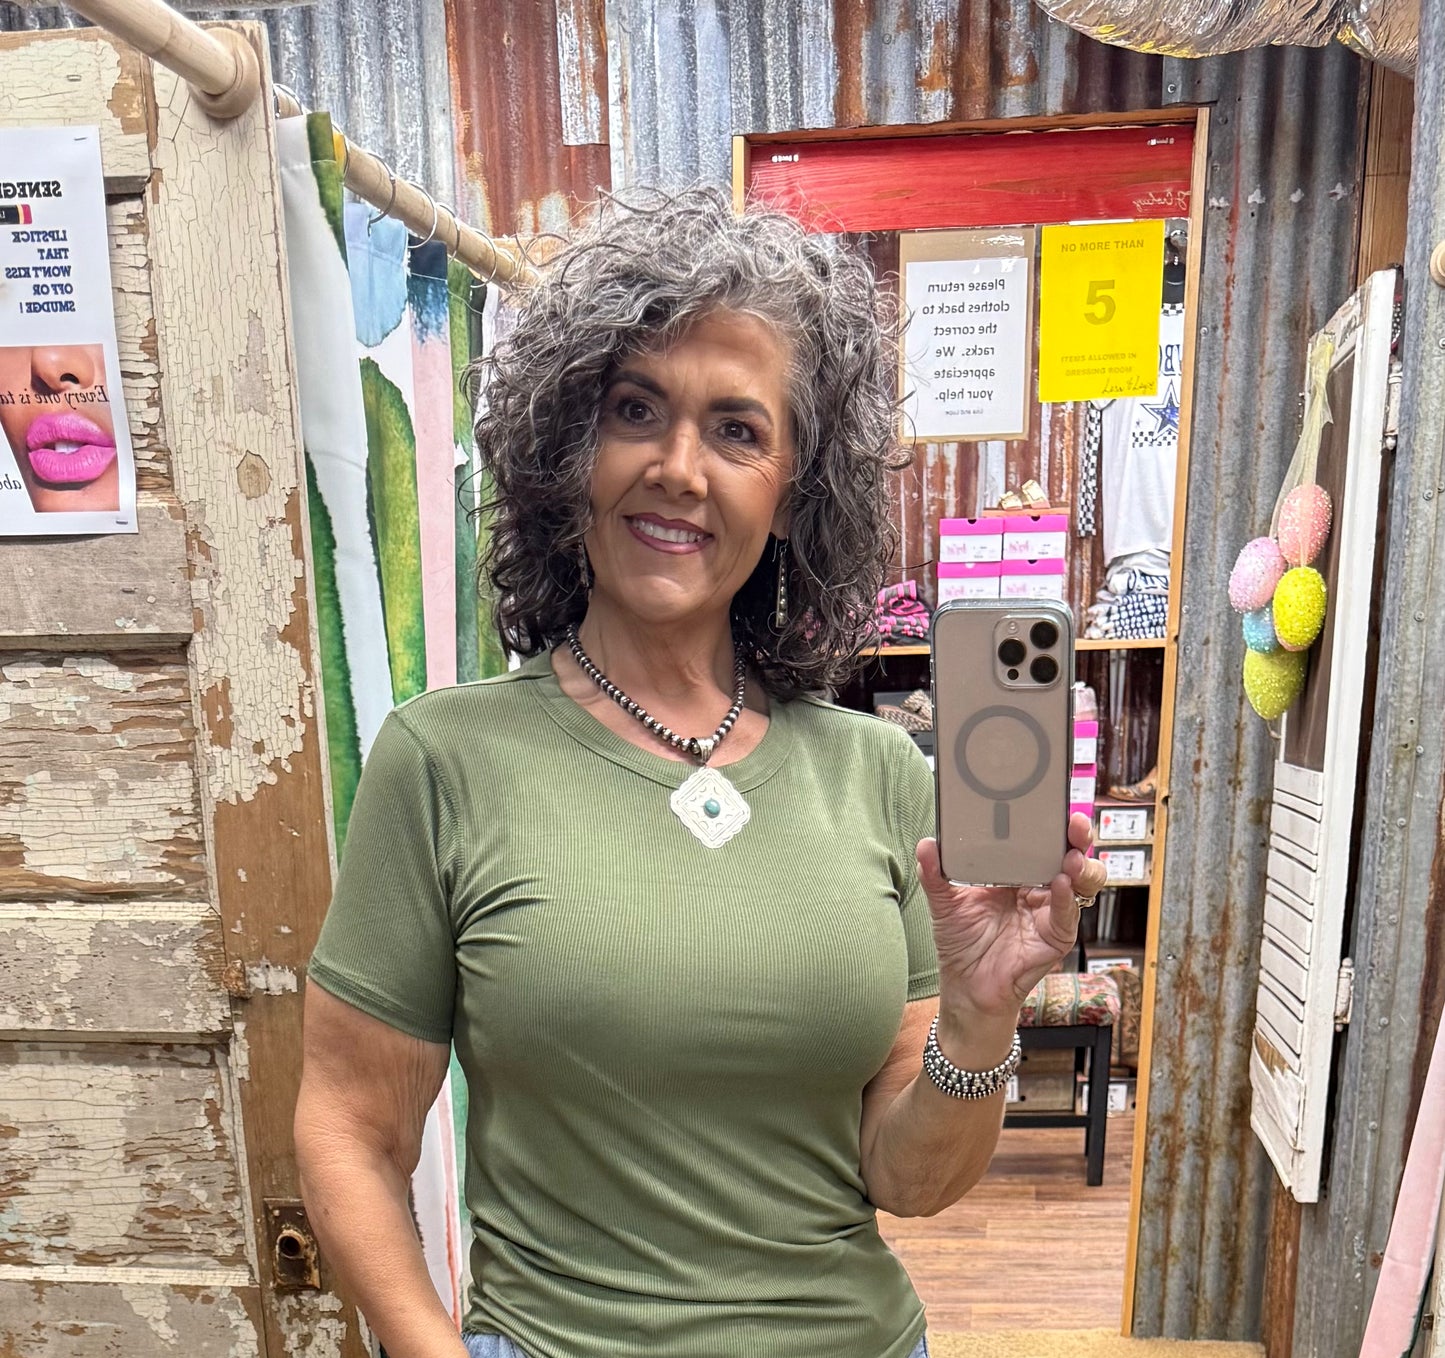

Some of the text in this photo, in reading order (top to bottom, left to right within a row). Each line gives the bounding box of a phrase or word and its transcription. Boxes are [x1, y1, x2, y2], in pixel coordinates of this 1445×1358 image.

[1061, 239, 1144, 253] NO MORE THAN
[1084, 279, 1116, 326] 5
[1061, 354, 1086, 363] ITEMS
[1088, 353, 1126, 361] ALLOWED
[1065, 366, 1132, 376] DRESSING ROOM
